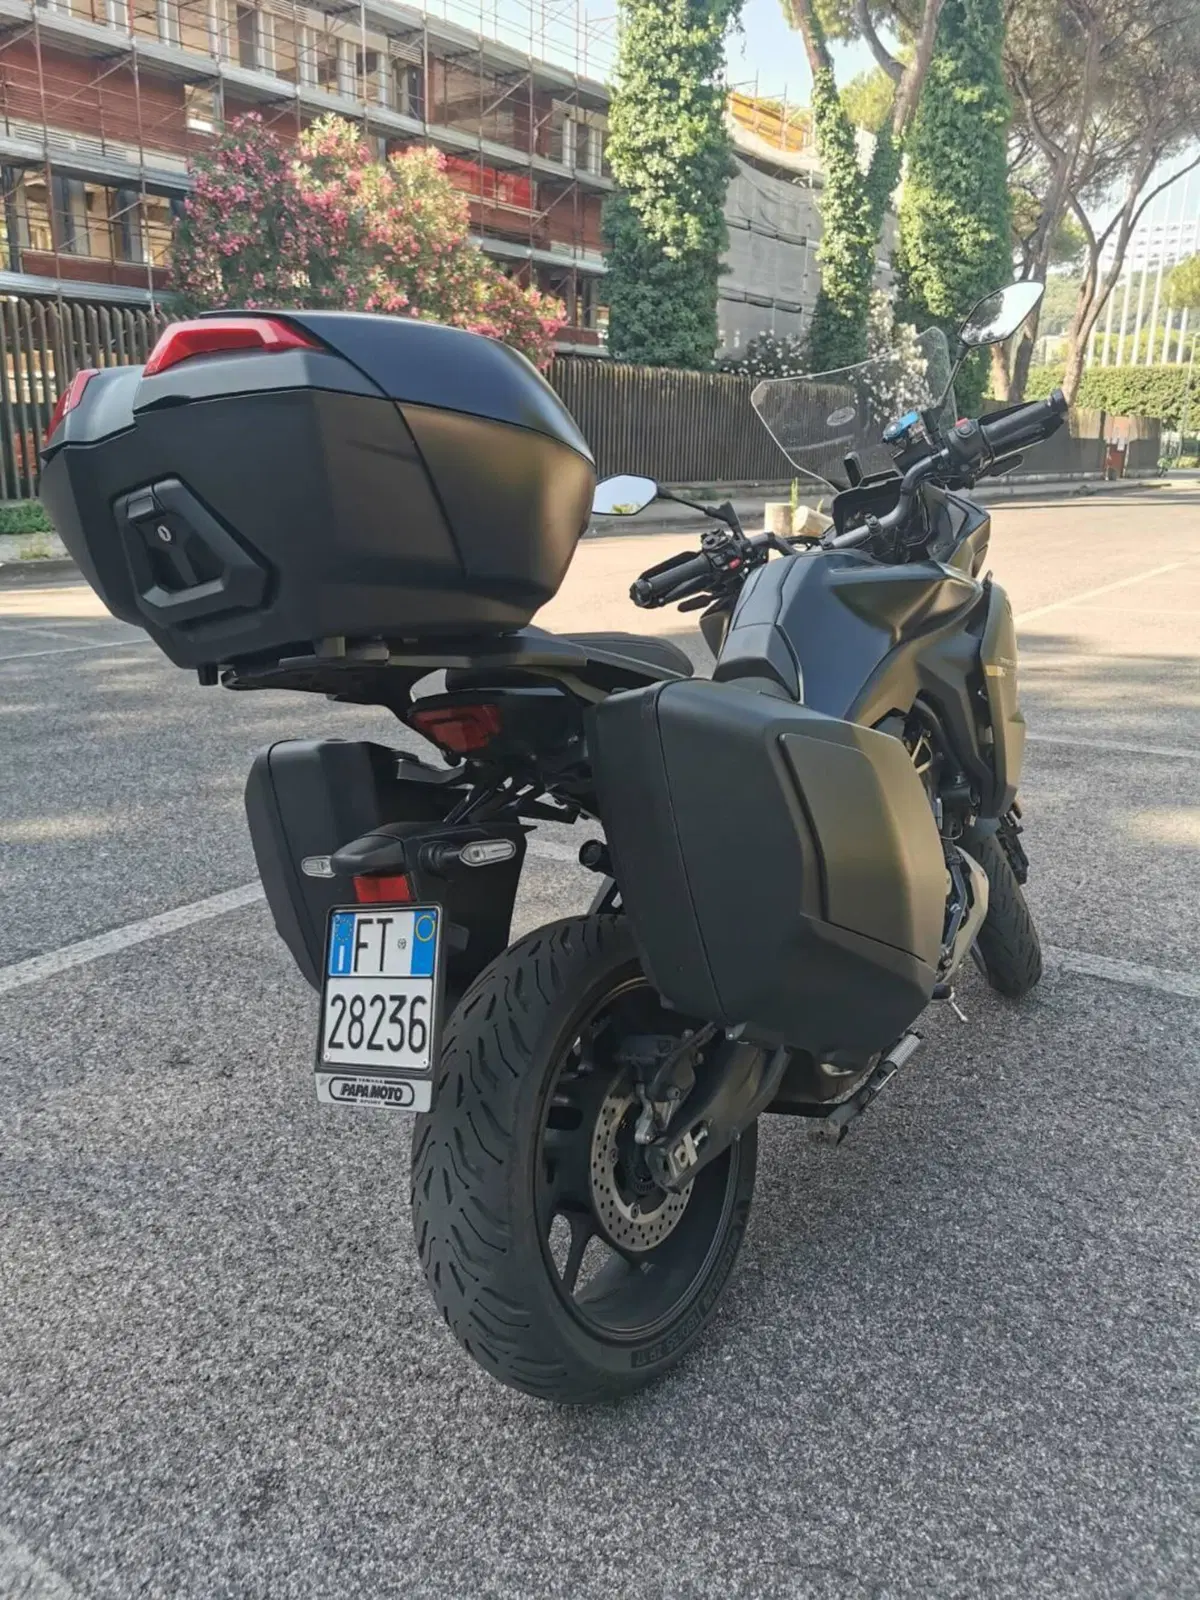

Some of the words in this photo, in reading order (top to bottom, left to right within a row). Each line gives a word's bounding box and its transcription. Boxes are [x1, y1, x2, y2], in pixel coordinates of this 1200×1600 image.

[353, 918, 393, 972] FT
[328, 993, 427, 1054] 28236
[340, 1083, 369, 1098] PAPA
[370, 1085, 403, 1101] MOTO
